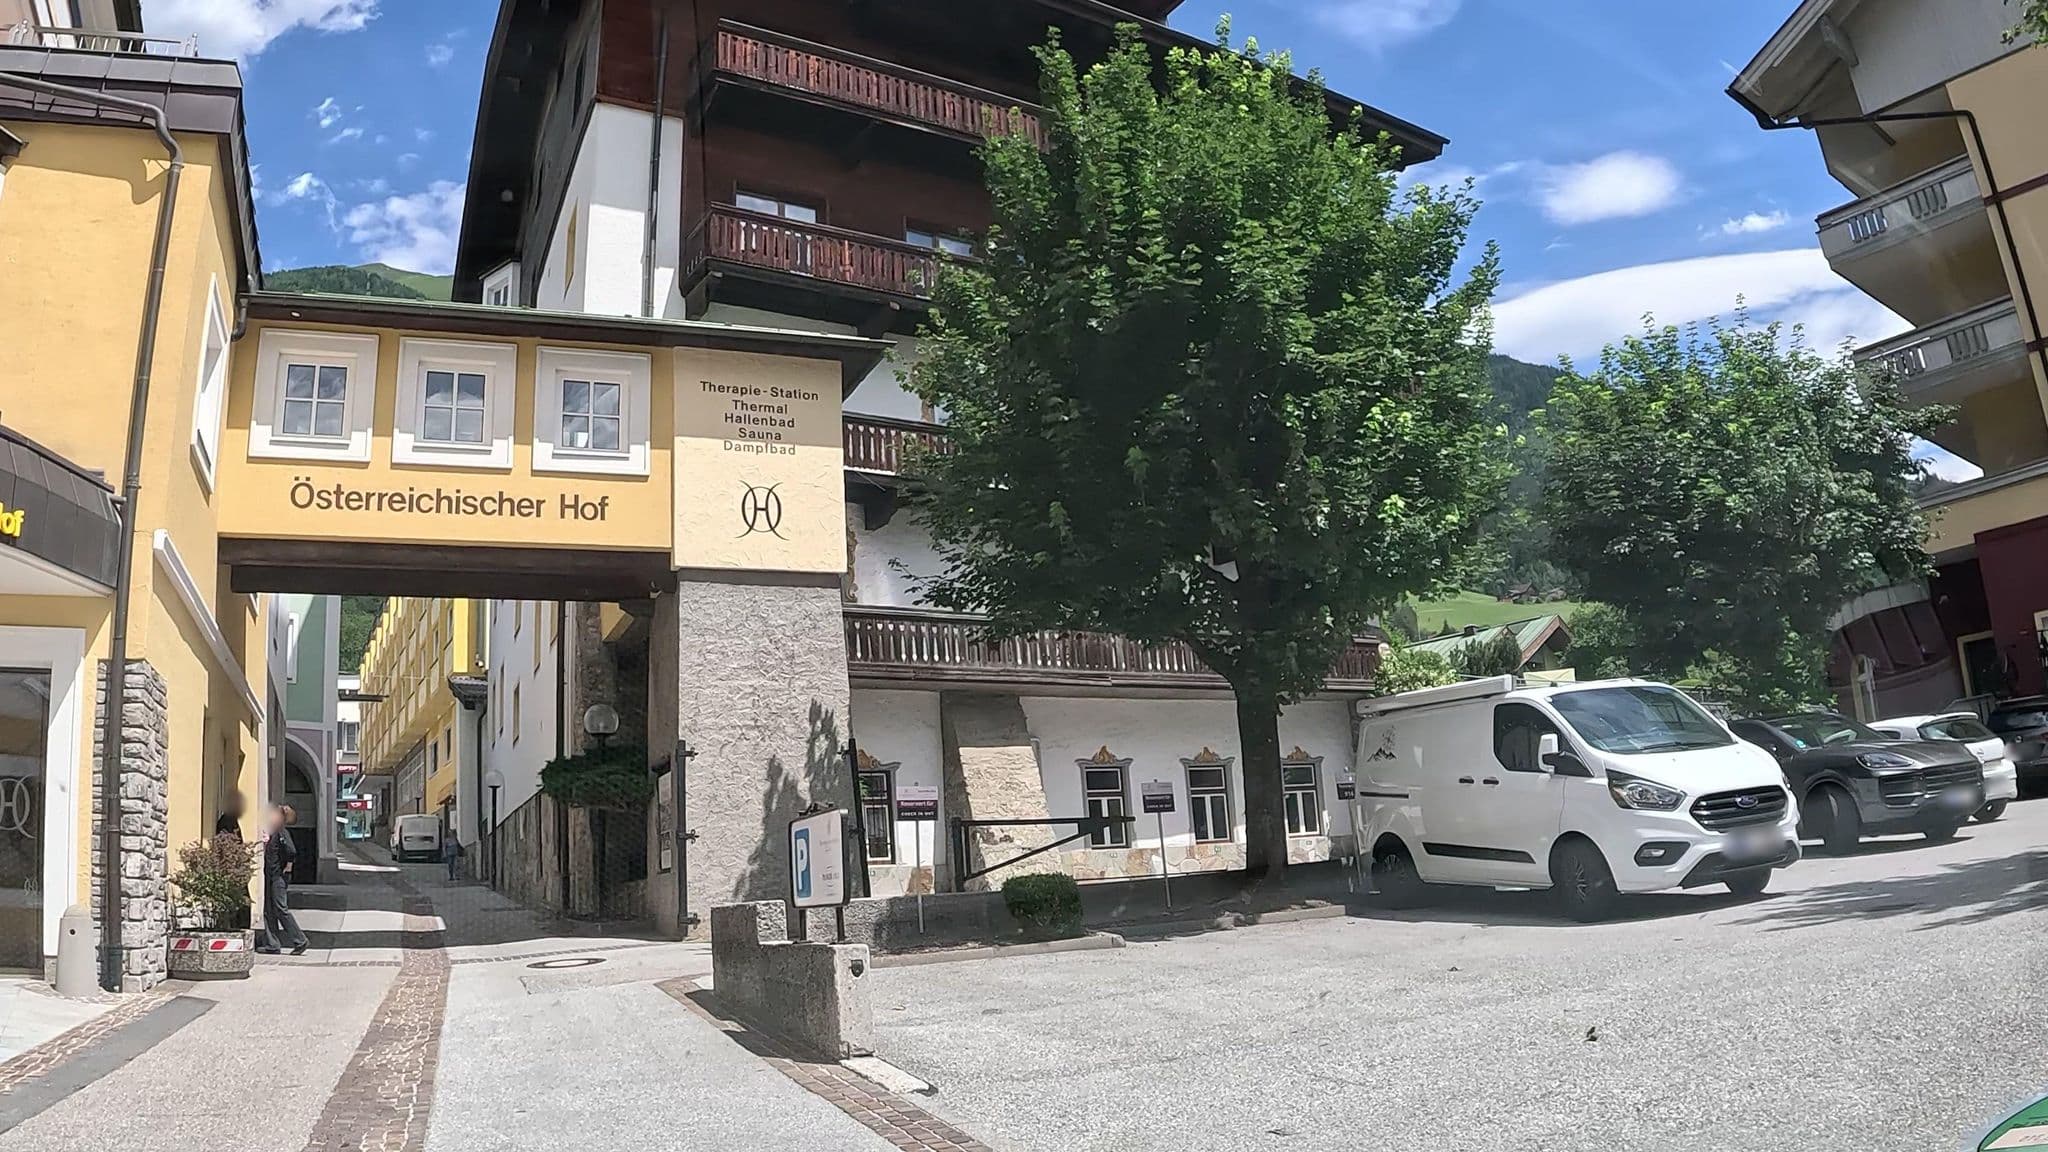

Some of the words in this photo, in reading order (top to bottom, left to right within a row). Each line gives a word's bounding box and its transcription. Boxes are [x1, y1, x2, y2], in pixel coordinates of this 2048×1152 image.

[732, 400, 788, 414] Thermal
[724, 413, 795, 428] Hallenbad
[738, 427, 782, 441] Sauna
[723, 440, 796, 455] Dampfbad
[290, 476, 546, 518] Österreichischer
[559, 493, 609, 521] Hof
[796, 838, 808, 891] P
